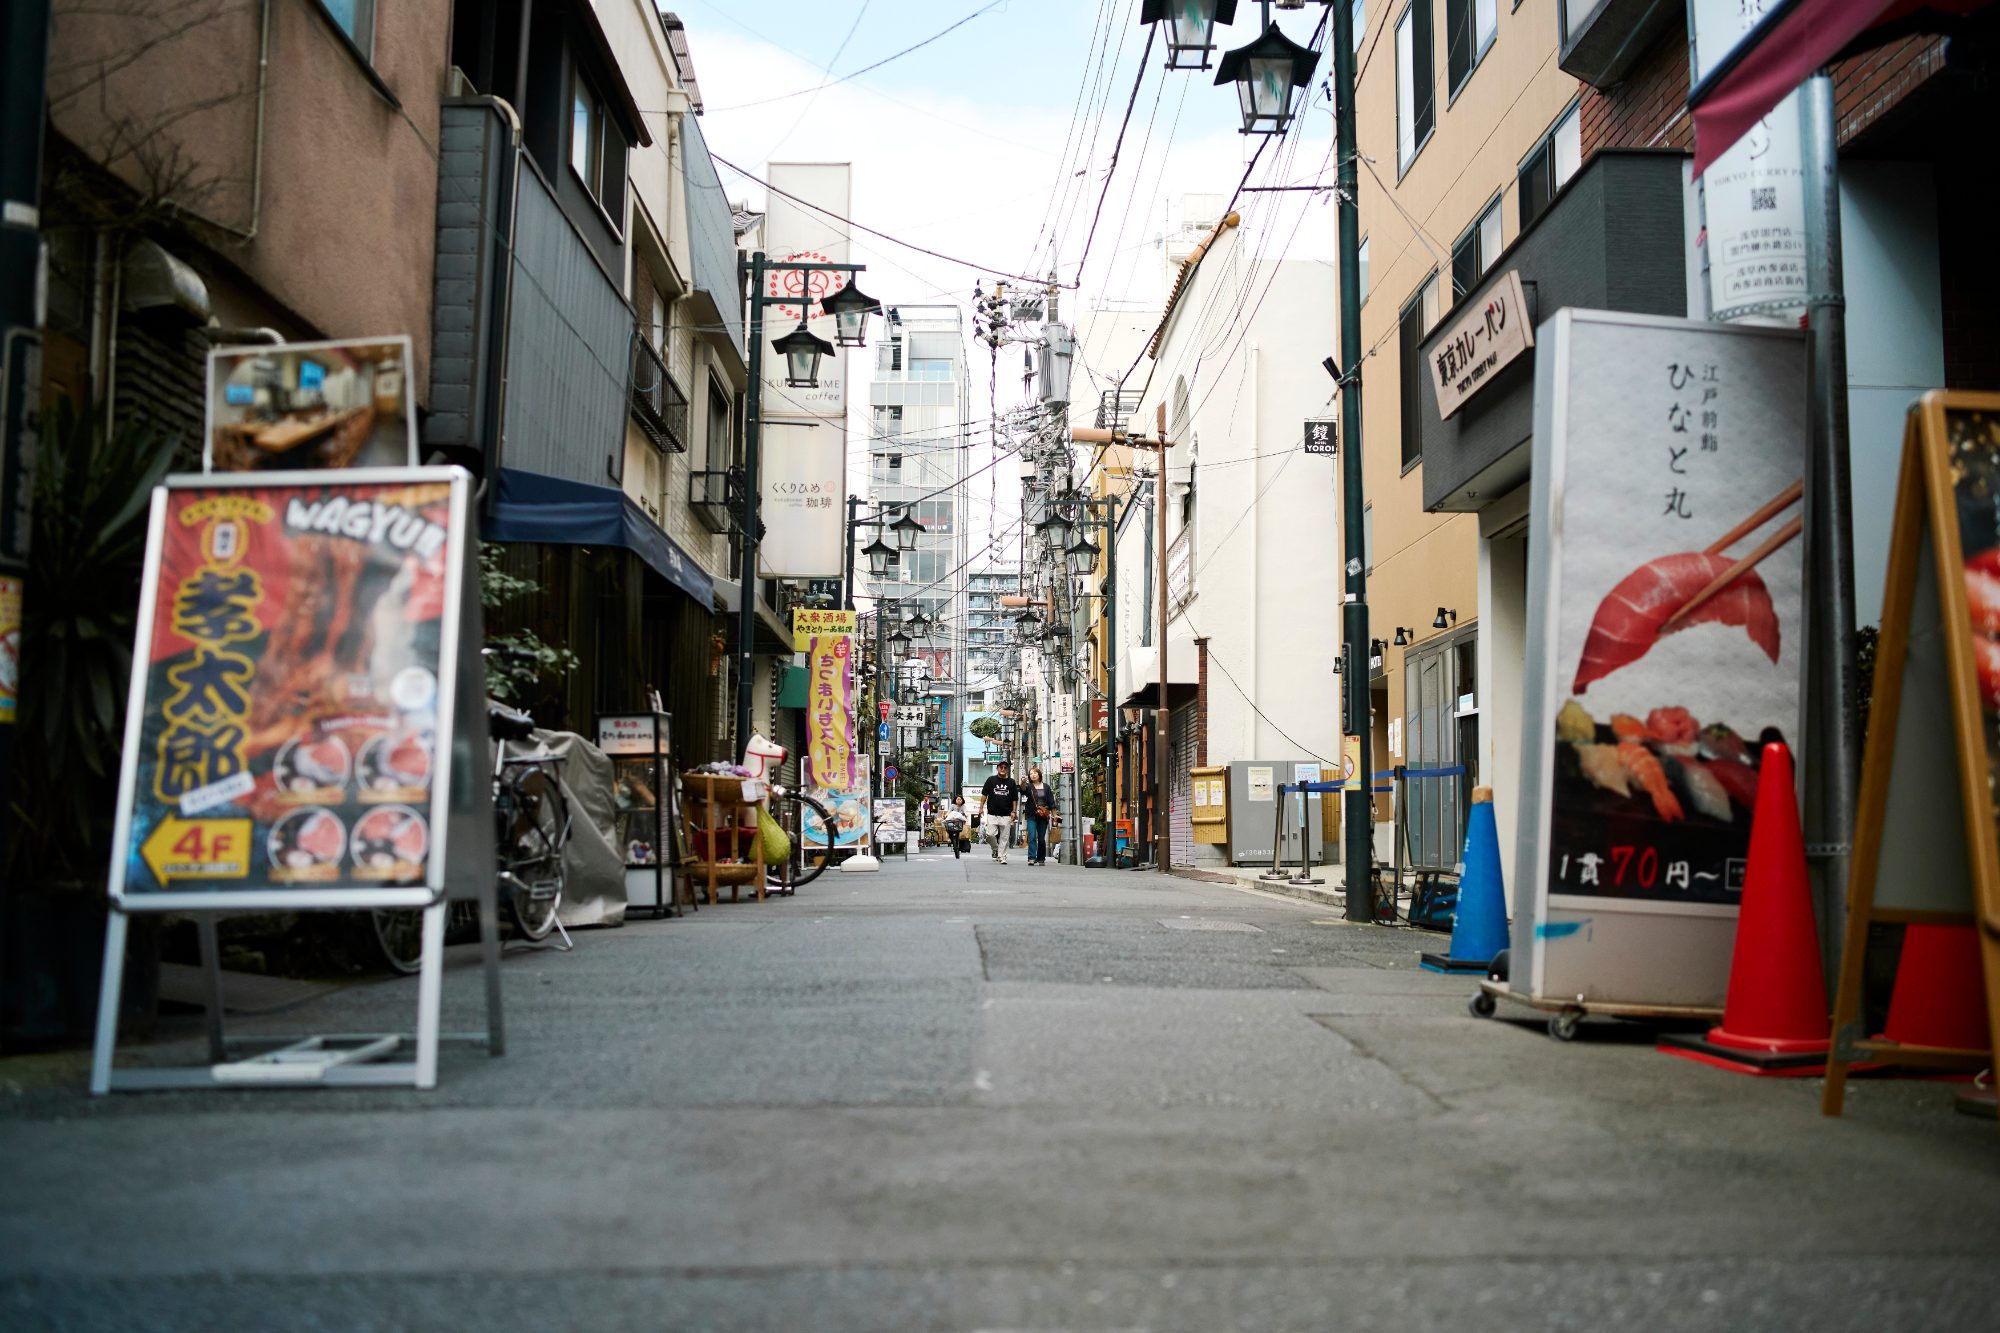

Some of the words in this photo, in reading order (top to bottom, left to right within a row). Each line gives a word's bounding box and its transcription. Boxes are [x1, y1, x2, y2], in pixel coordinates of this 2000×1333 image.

[1436, 297, 1506, 387] 東京カレーパン
[805, 392, 840, 400] coffee
[1662, 362, 1695, 520] ひなと丸
[772, 482, 821, 493] くくりひめ
[806, 497, 832, 508] 珈琲
[797, 611, 847, 624] 大衆酒場
[796, 625, 853, 633] やきとり一品料理
[171, 825, 233, 862] 4F
